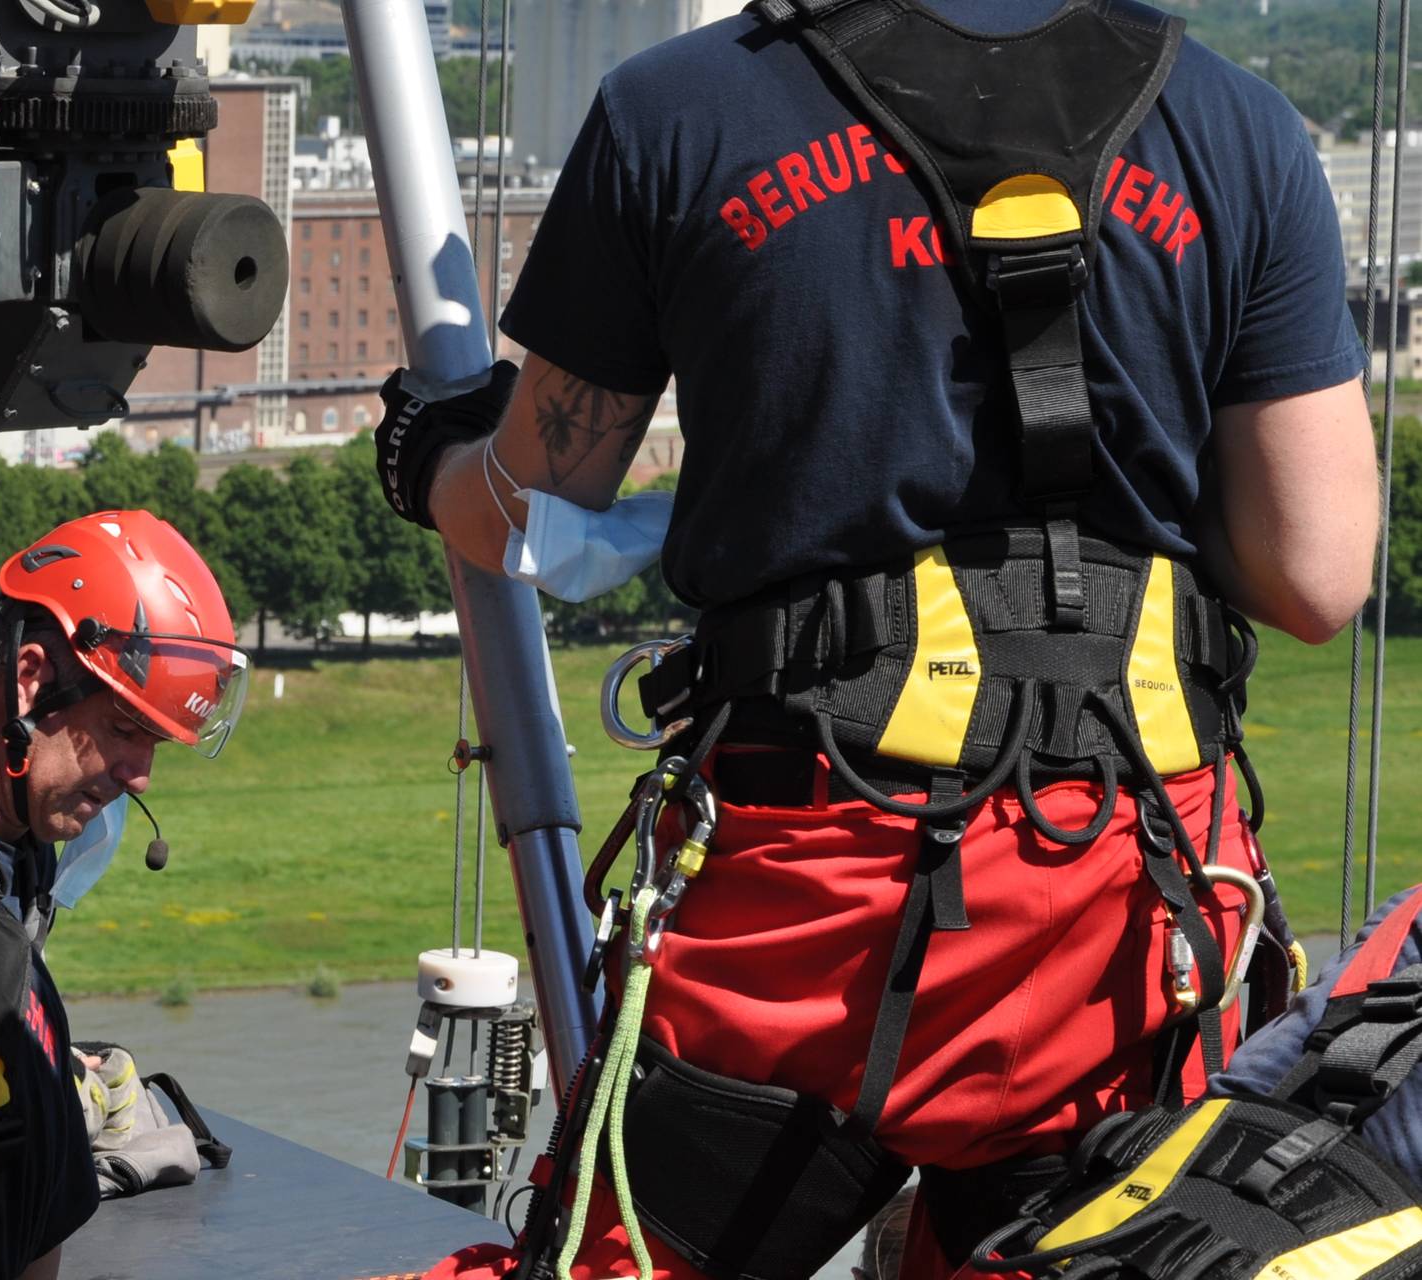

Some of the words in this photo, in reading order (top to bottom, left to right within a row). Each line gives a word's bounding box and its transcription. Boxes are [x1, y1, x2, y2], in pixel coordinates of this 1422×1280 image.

[928, 660, 976, 681] PETZL
[1134, 679, 1175, 692] SEQUOIA
[1115, 1183, 1152, 1201] PETZL
